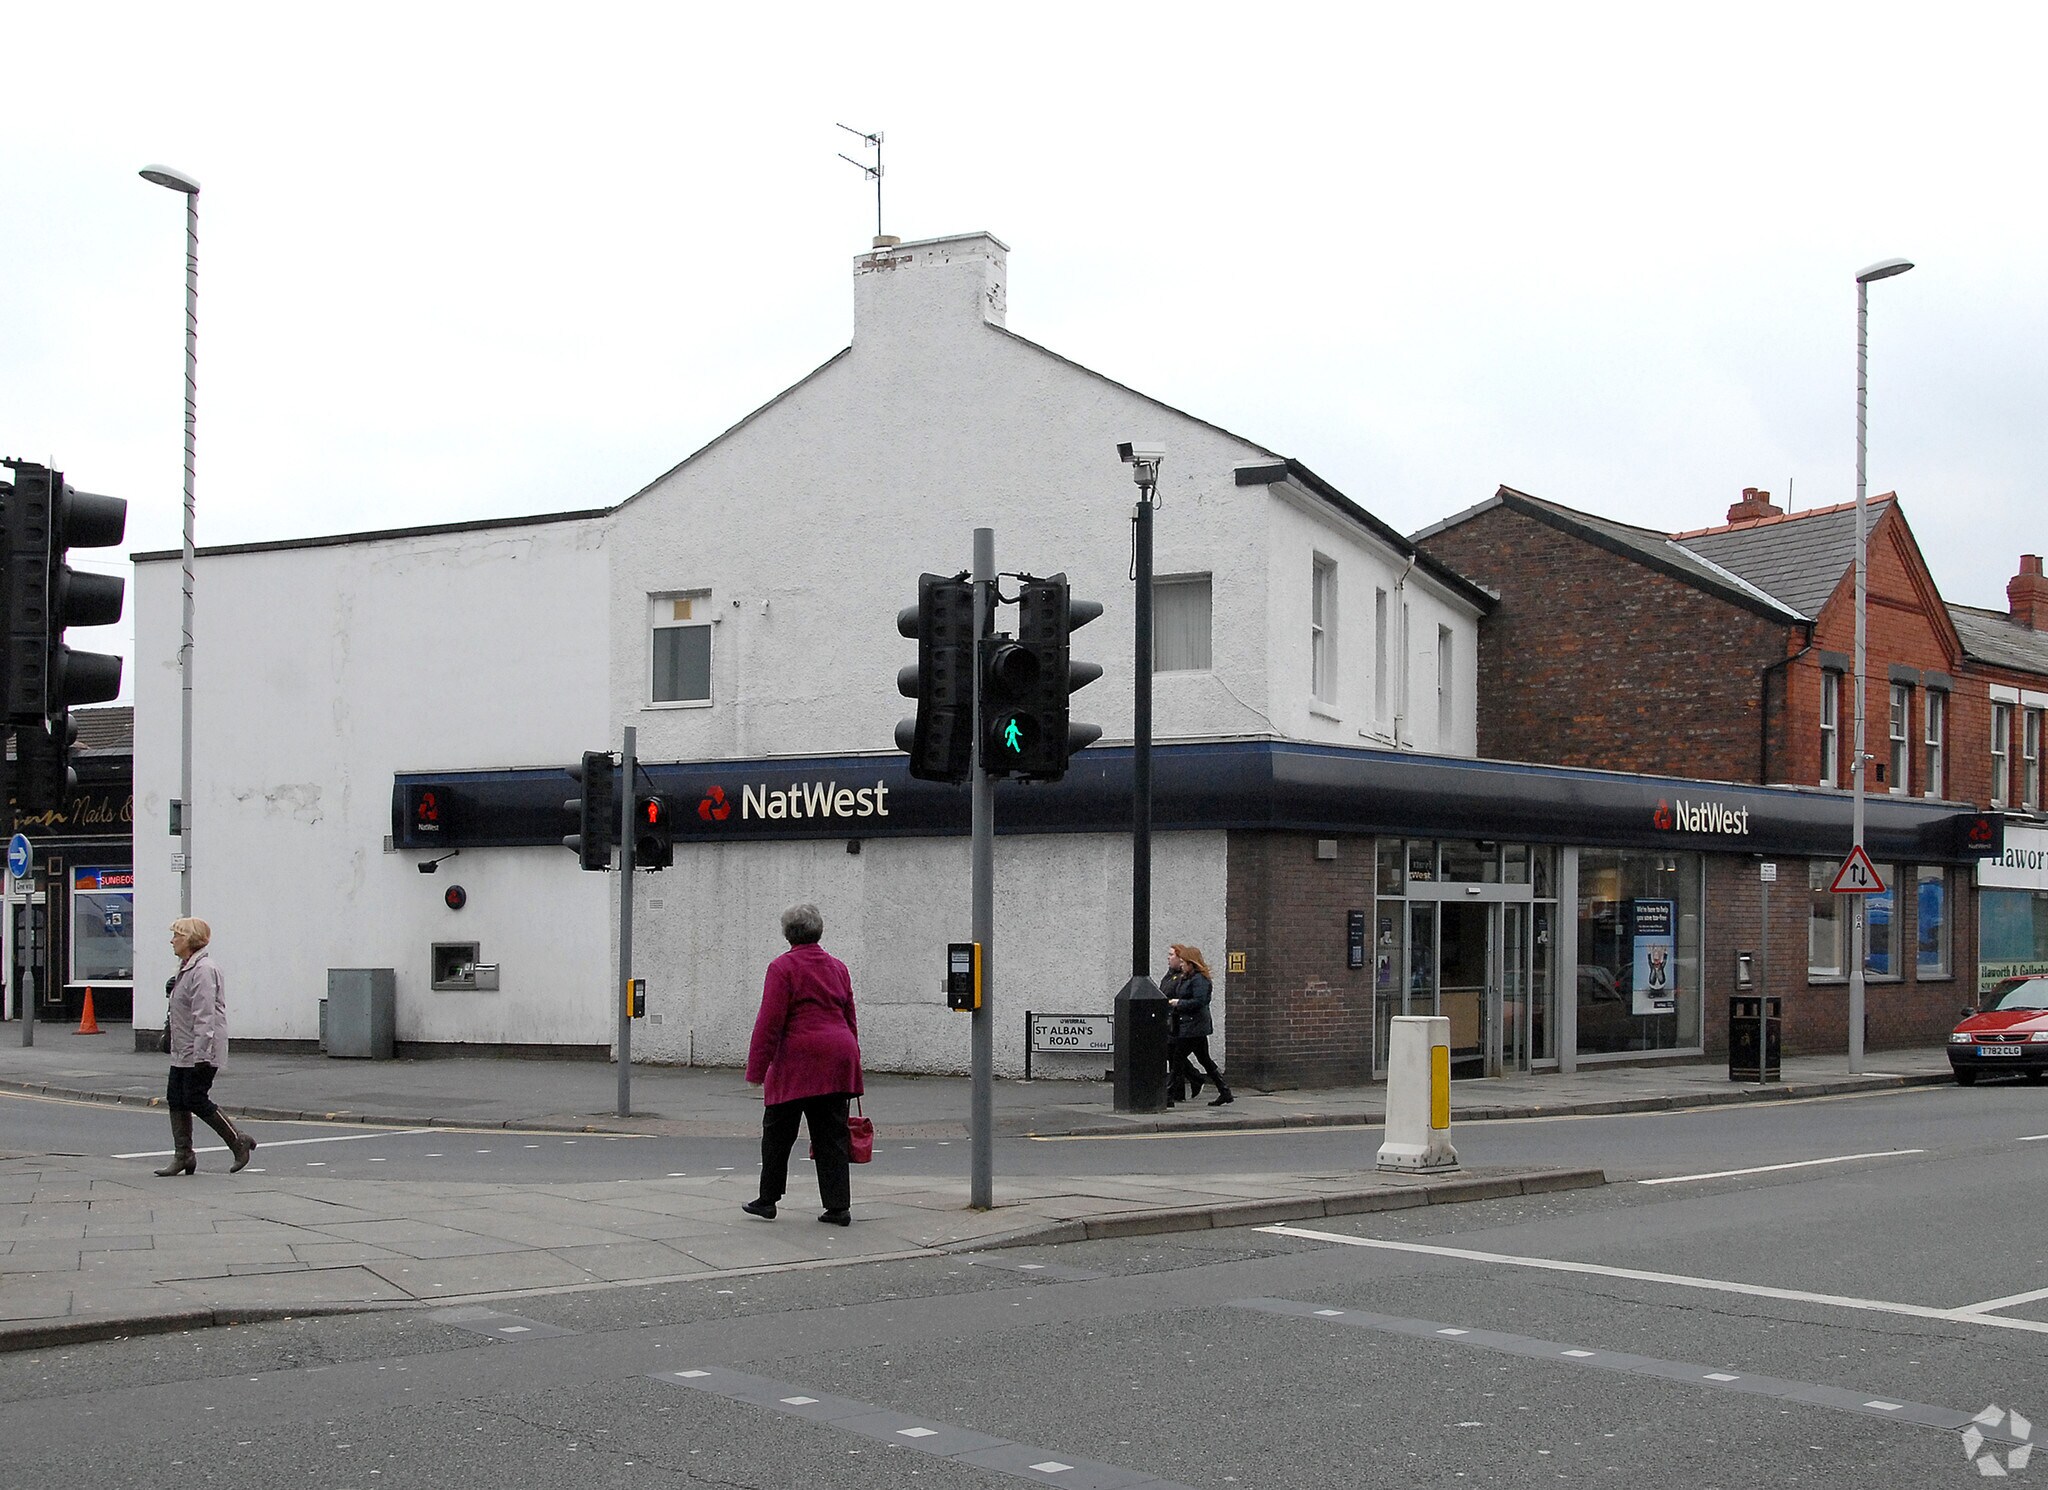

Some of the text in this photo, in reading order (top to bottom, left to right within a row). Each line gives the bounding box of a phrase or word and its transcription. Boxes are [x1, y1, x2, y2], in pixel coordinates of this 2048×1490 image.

[742, 779, 889, 819] NatWest
[72, 795, 115, 826] Nails
[1676, 799, 1749, 835] NatWest
[418, 823, 439, 831] NatWest
[1992, 848, 2048, 870] awor
[101, 875, 133, 885] SUNBEDS
[1231, 954, 1243, 970] H
[1981, 965, 2010, 977] Haworth
[2012, 965, 2017, 976] &
[1035, 1026, 1093, 1035] ST ALBAN'S
[1049, 1036, 1079, 1045] ROAD
[1982, 1047, 2020, 1055] T782 CLG
